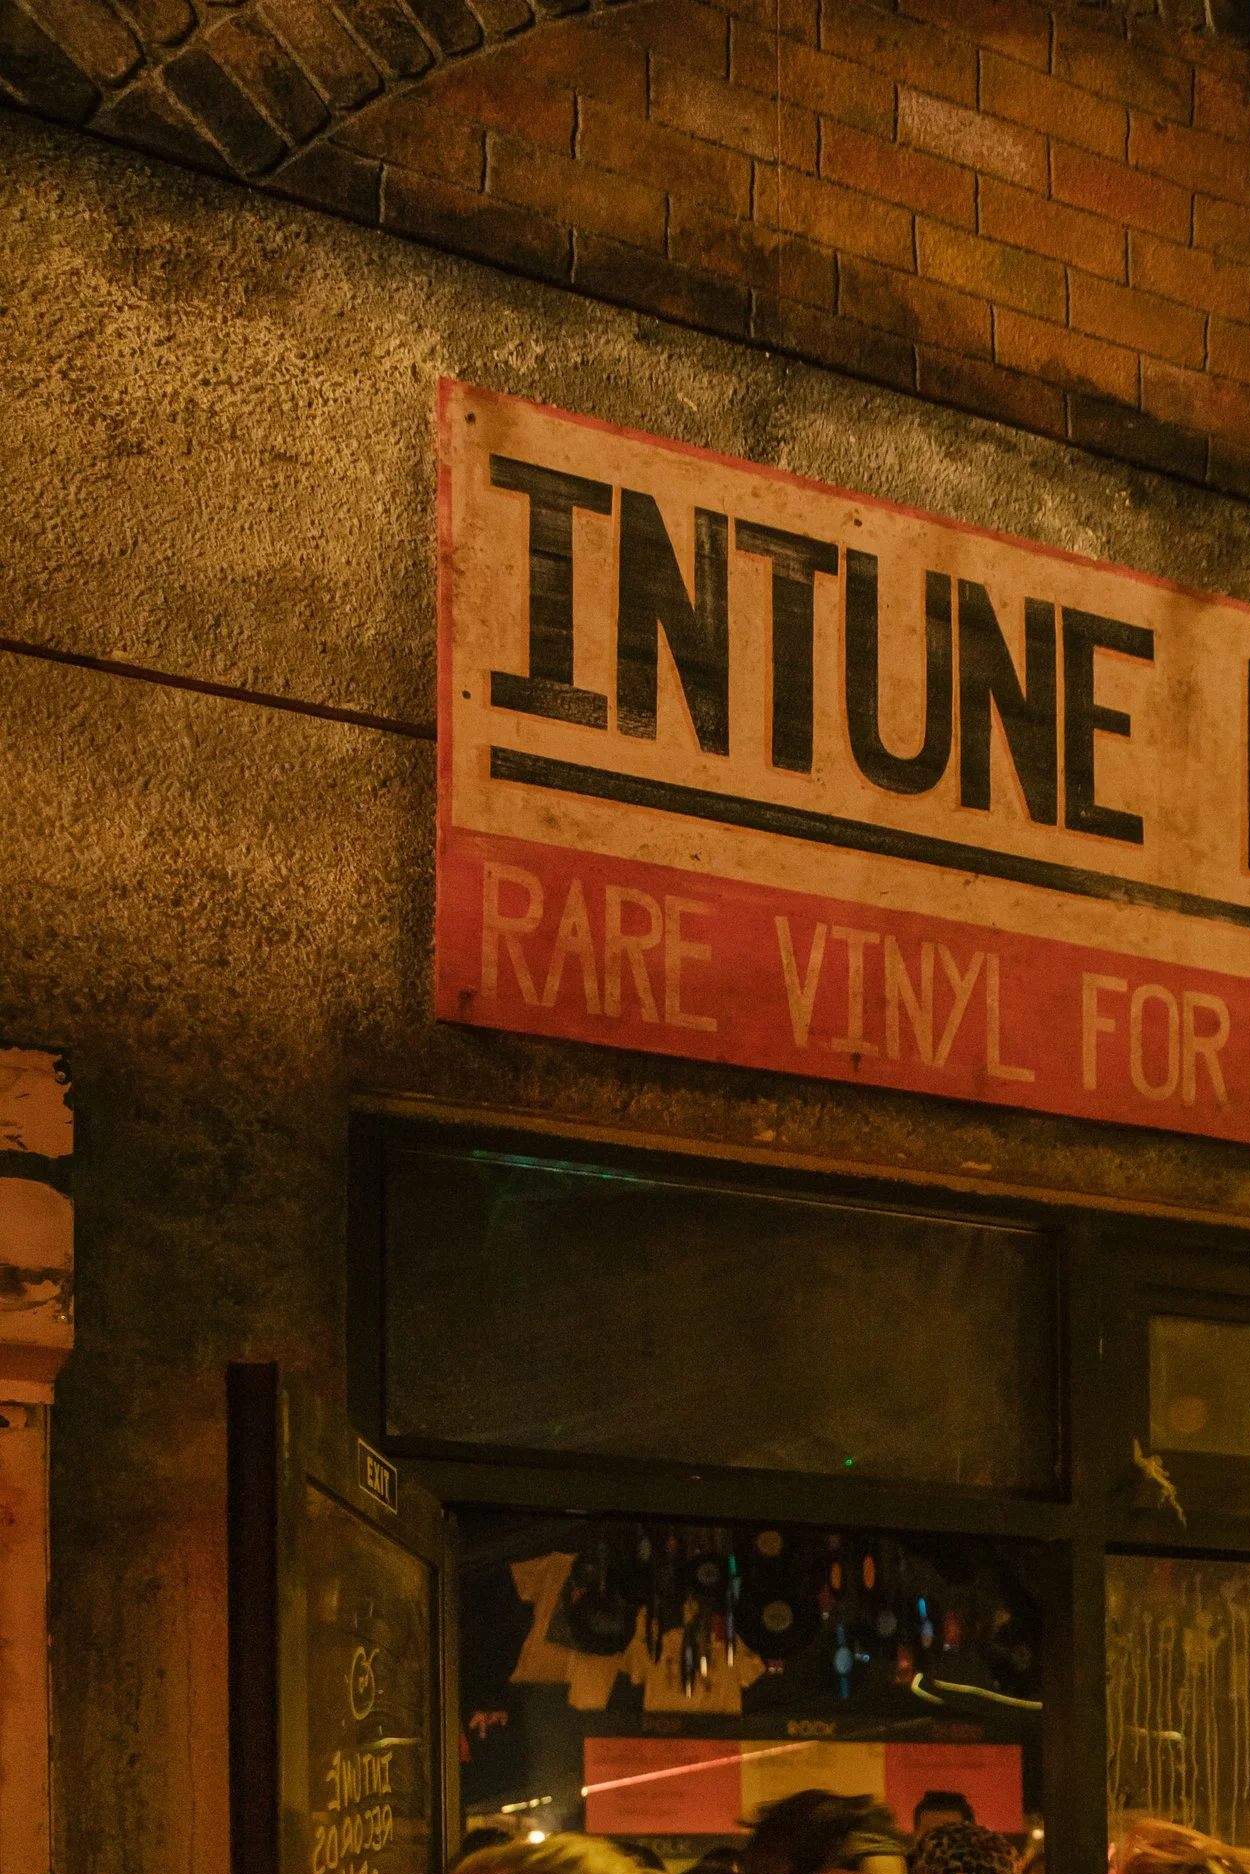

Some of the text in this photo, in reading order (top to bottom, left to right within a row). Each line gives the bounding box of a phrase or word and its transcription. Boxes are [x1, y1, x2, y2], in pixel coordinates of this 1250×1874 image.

[489, 453, 1155, 846] INTUNE
[481, 860, 718, 1032] RARE
[773, 914, 1036, 1083] VINYL
[1080, 971, 1231, 1110] FOR
[366, 1455, 390, 1502] EXIT
